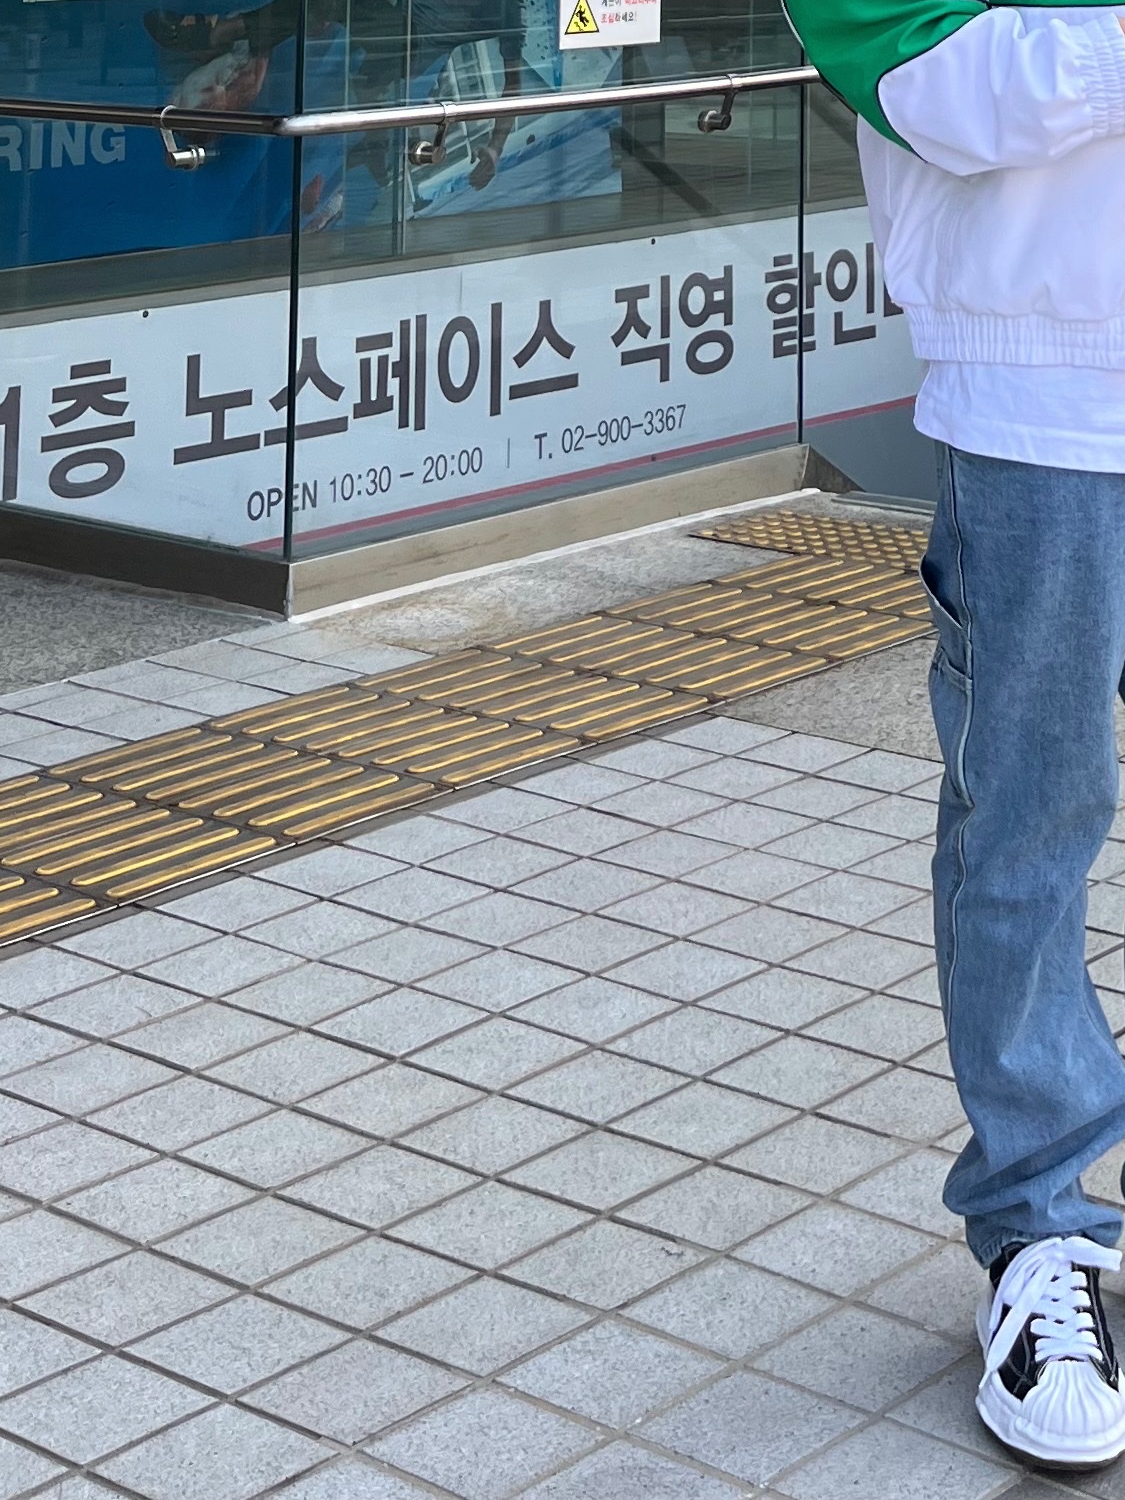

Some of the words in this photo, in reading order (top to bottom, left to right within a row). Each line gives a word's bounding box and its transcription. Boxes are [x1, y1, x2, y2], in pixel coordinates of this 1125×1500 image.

[0, 358, 136, 500] 1층
[173, 298, 579, 466] 노스페이스
[611, 263, 735, 384] 직영
[764, 241, 905, 359] 할인
[246, 478, 319, 522] OPEN
[328, 465, 393, 503] 10:30
[421, 445, 484, 485] 20:00
[533, 431, 554, 461] T.
[561, 403, 688, 454] 02-900-3367
